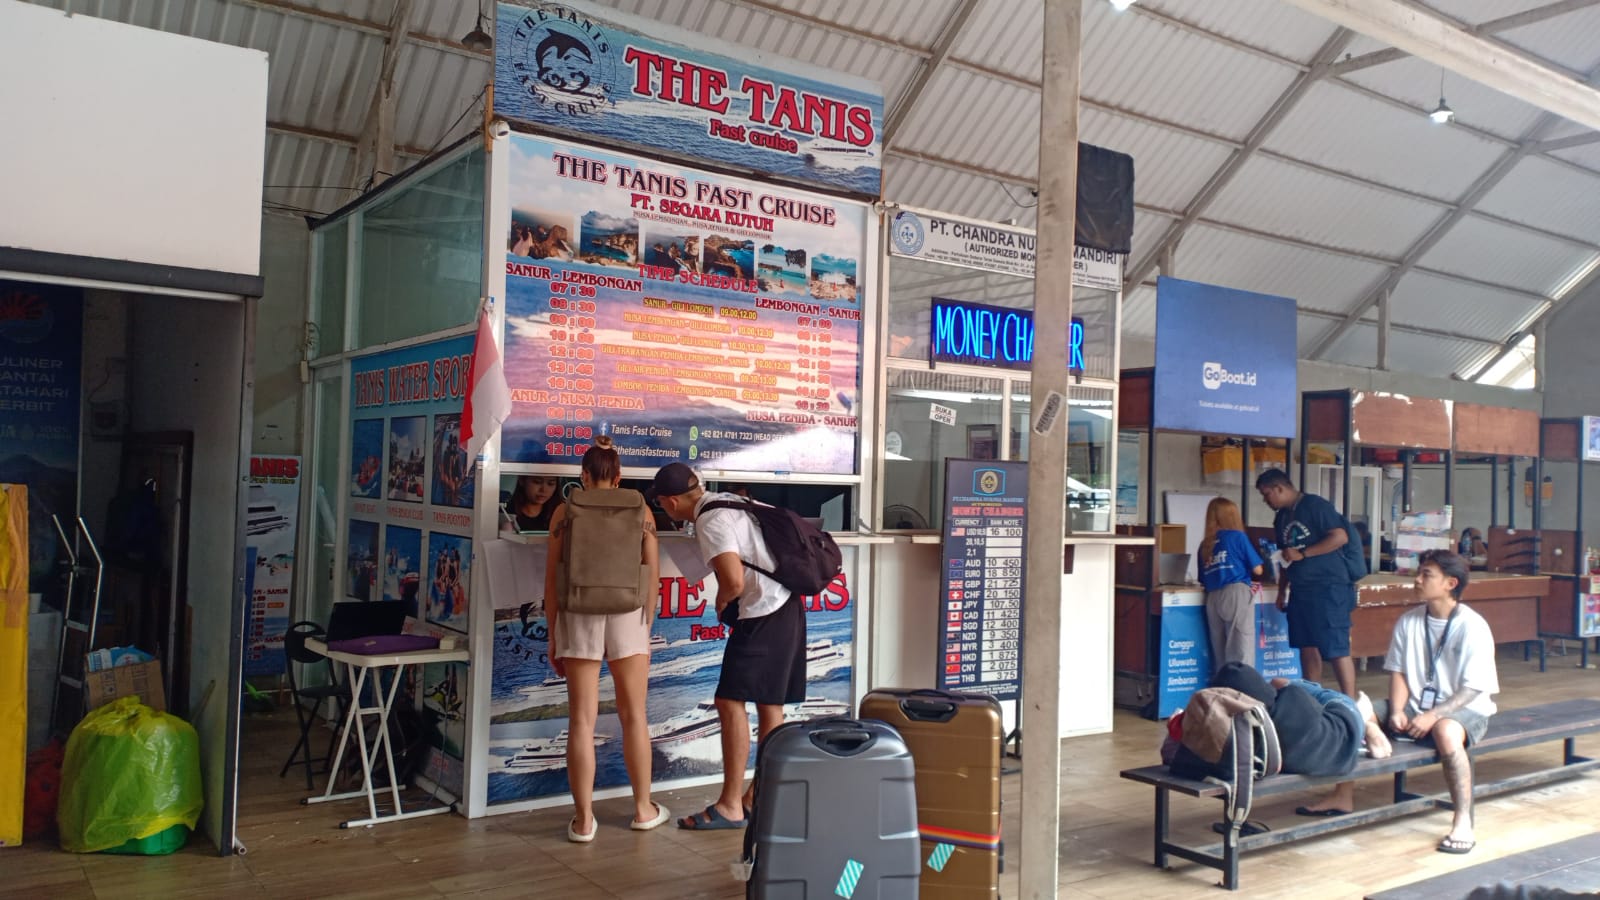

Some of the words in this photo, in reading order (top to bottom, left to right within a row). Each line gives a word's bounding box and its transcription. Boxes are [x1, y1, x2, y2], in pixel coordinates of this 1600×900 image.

[515, 8, 548, 39] THE
[555, 7, 609, 53] TANIS
[624, 46, 729, 113] THE
[741, 79, 874, 147] TANIS
[710, 119, 746, 141] Fast
[750, 130, 798, 154] cruise
[553, 153, 607, 184] THE
[615, 166, 687, 198] TANIS
[696, 181, 754, 211] FAST
[758, 195, 836, 227] CRUISE
[631, 193, 655, 211] PT.
[660, 199, 721, 223] SEGARA
[725, 211, 774, 232] KUTUH
[930, 219, 949, 237] PT.
[953, 223, 1015, 249] CHANDRA
[1017, 234, 1037, 251] NU
[969, 244, 1020, 260] AUTHORIZED
[505, 262, 551, 280] SANUR
[562, 270, 642, 292] LEMBONGAN
[637, 263, 675, 284] TIME
[679, 270, 759, 294] SCHEDULE
[550, 282, 568, 293] 07
[578, 286, 596, 297] 30
[643, 298, 667, 308] SANUR
[755, 298, 820, 316] LEMBONGAN
[828, 307, 861, 320] SANUR
[935, 305, 1000, 359] MONEY
[355, 369, 385, 407] TANIS
[388, 361, 430, 404] WATER
[433, 353, 475, 400] SPOR
[1204, 367, 1257, 386] GoBoat.id
[511, 388, 549, 403] ANUR
[559, 391, 595, 407] NUSA
[598, 394, 645, 410] PENIDA
[935, 405, 952, 416] BUKA
[746, 410, 775, 422] NUSA
[778, 412, 816, 425] PENIDA
[824, 414, 858, 428] SANUR
[934, 413, 951, 424] OPEN
[611, 423, 631, 434] Tanis
[632, 425, 650, 436] Fast
[650, 426, 673, 438] Cruise
[546, 443, 564, 455] 12
[966, 549, 976, 557] 2,1
[1002, 558, 1019, 568] 450
[965, 570, 981, 578] EURO
[1002, 569, 1020, 577] 850
[965, 580, 981, 588] GBP
[987, 580, 998, 588] 21
[964, 591, 981, 599] CHF
[986, 590, 998, 598] 20
[1004, 590, 1019, 598] 150
[963, 601, 978, 609] JPY
[1001, 610, 1018, 618] 425
[963, 622, 978, 630] SGD
[1001, 620, 1018, 628] 400
[690, 623, 726, 641] Fast
[962, 633, 977, 641] NZD
[1001, 630, 1017, 639] 350
[962, 643, 978, 651] MYR
[1000, 640, 1018, 649] 400
[1169, 639, 1194, 651] Canggu
[961, 664, 977, 672] CNY
[998, 660, 1016, 669] 075
[997, 671, 1016, 680] 375
[1167, 676, 1198, 686] Jimbaran
